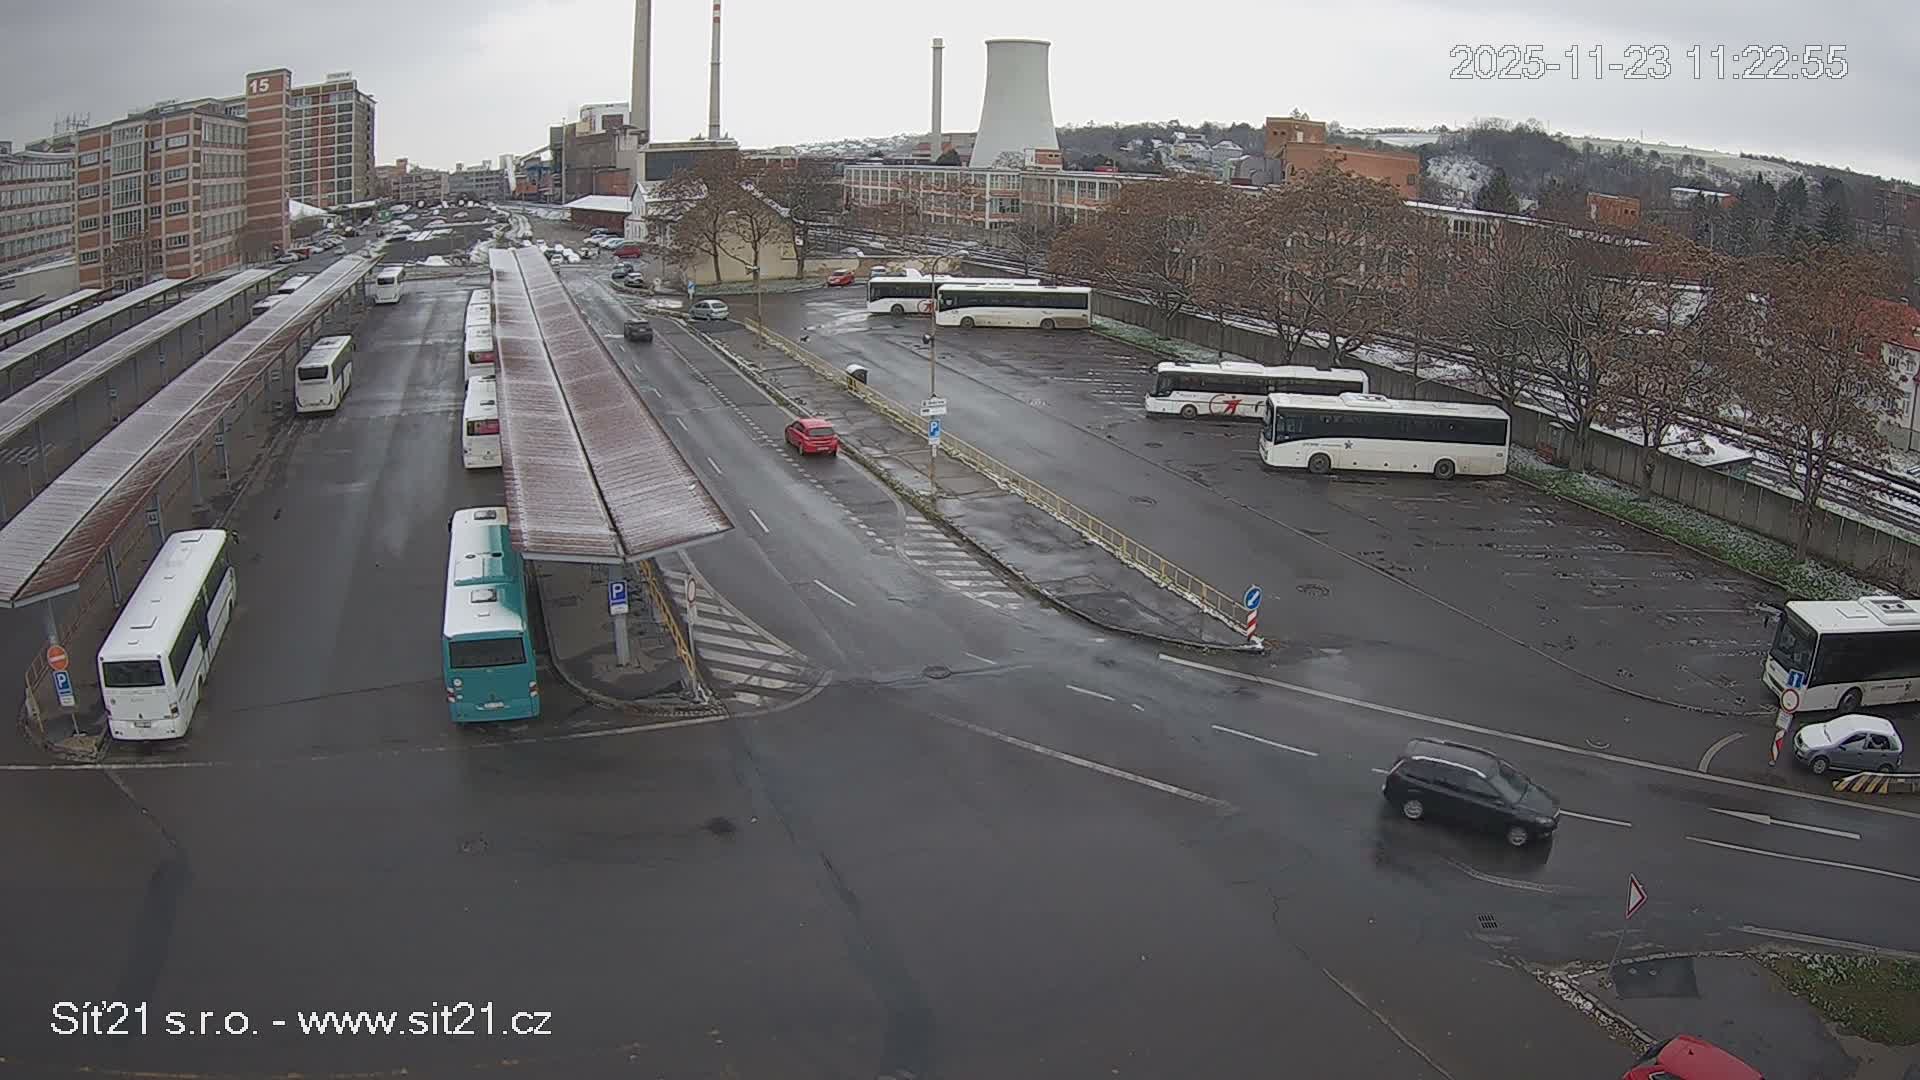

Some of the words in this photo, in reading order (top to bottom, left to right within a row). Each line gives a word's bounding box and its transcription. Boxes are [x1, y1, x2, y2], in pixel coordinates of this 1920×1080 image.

[249, 78, 271, 94] 15
[930, 421, 938, 433] P
[612, 583, 624, 600] P
[57, 673, 67, 689] P
